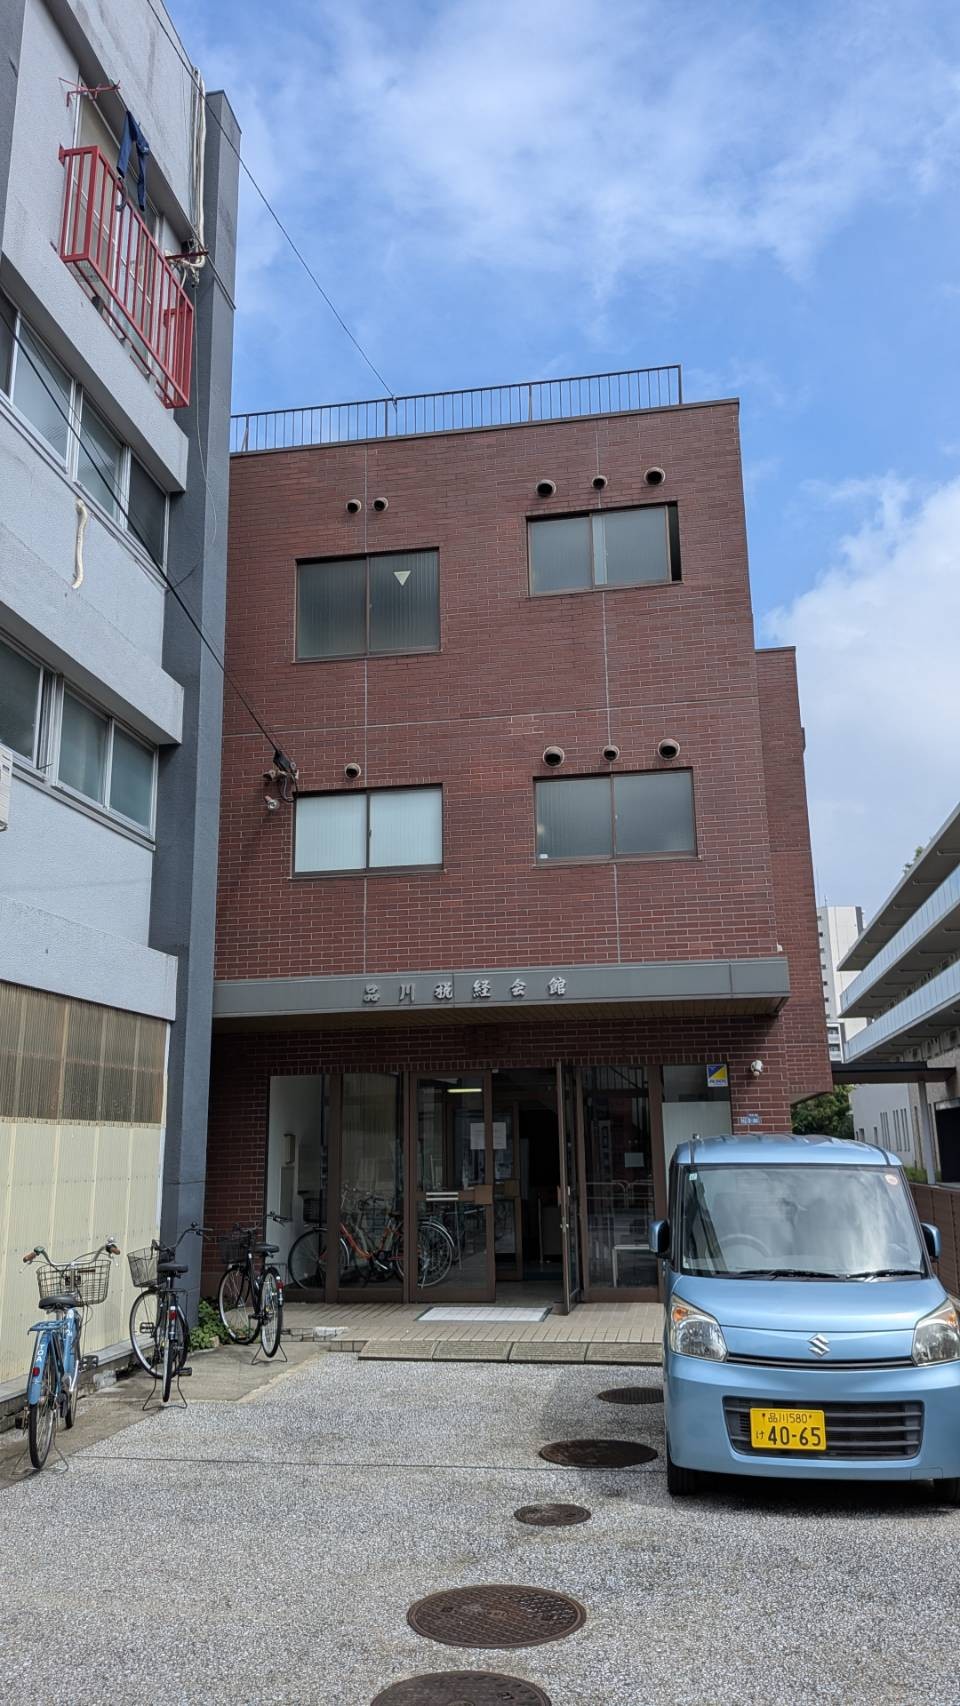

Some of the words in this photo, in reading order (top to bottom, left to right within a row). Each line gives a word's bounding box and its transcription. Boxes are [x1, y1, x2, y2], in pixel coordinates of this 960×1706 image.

[364, 976, 567, 1003] 品川税経会館
[768, 1425, 821, 1446] 40-65
